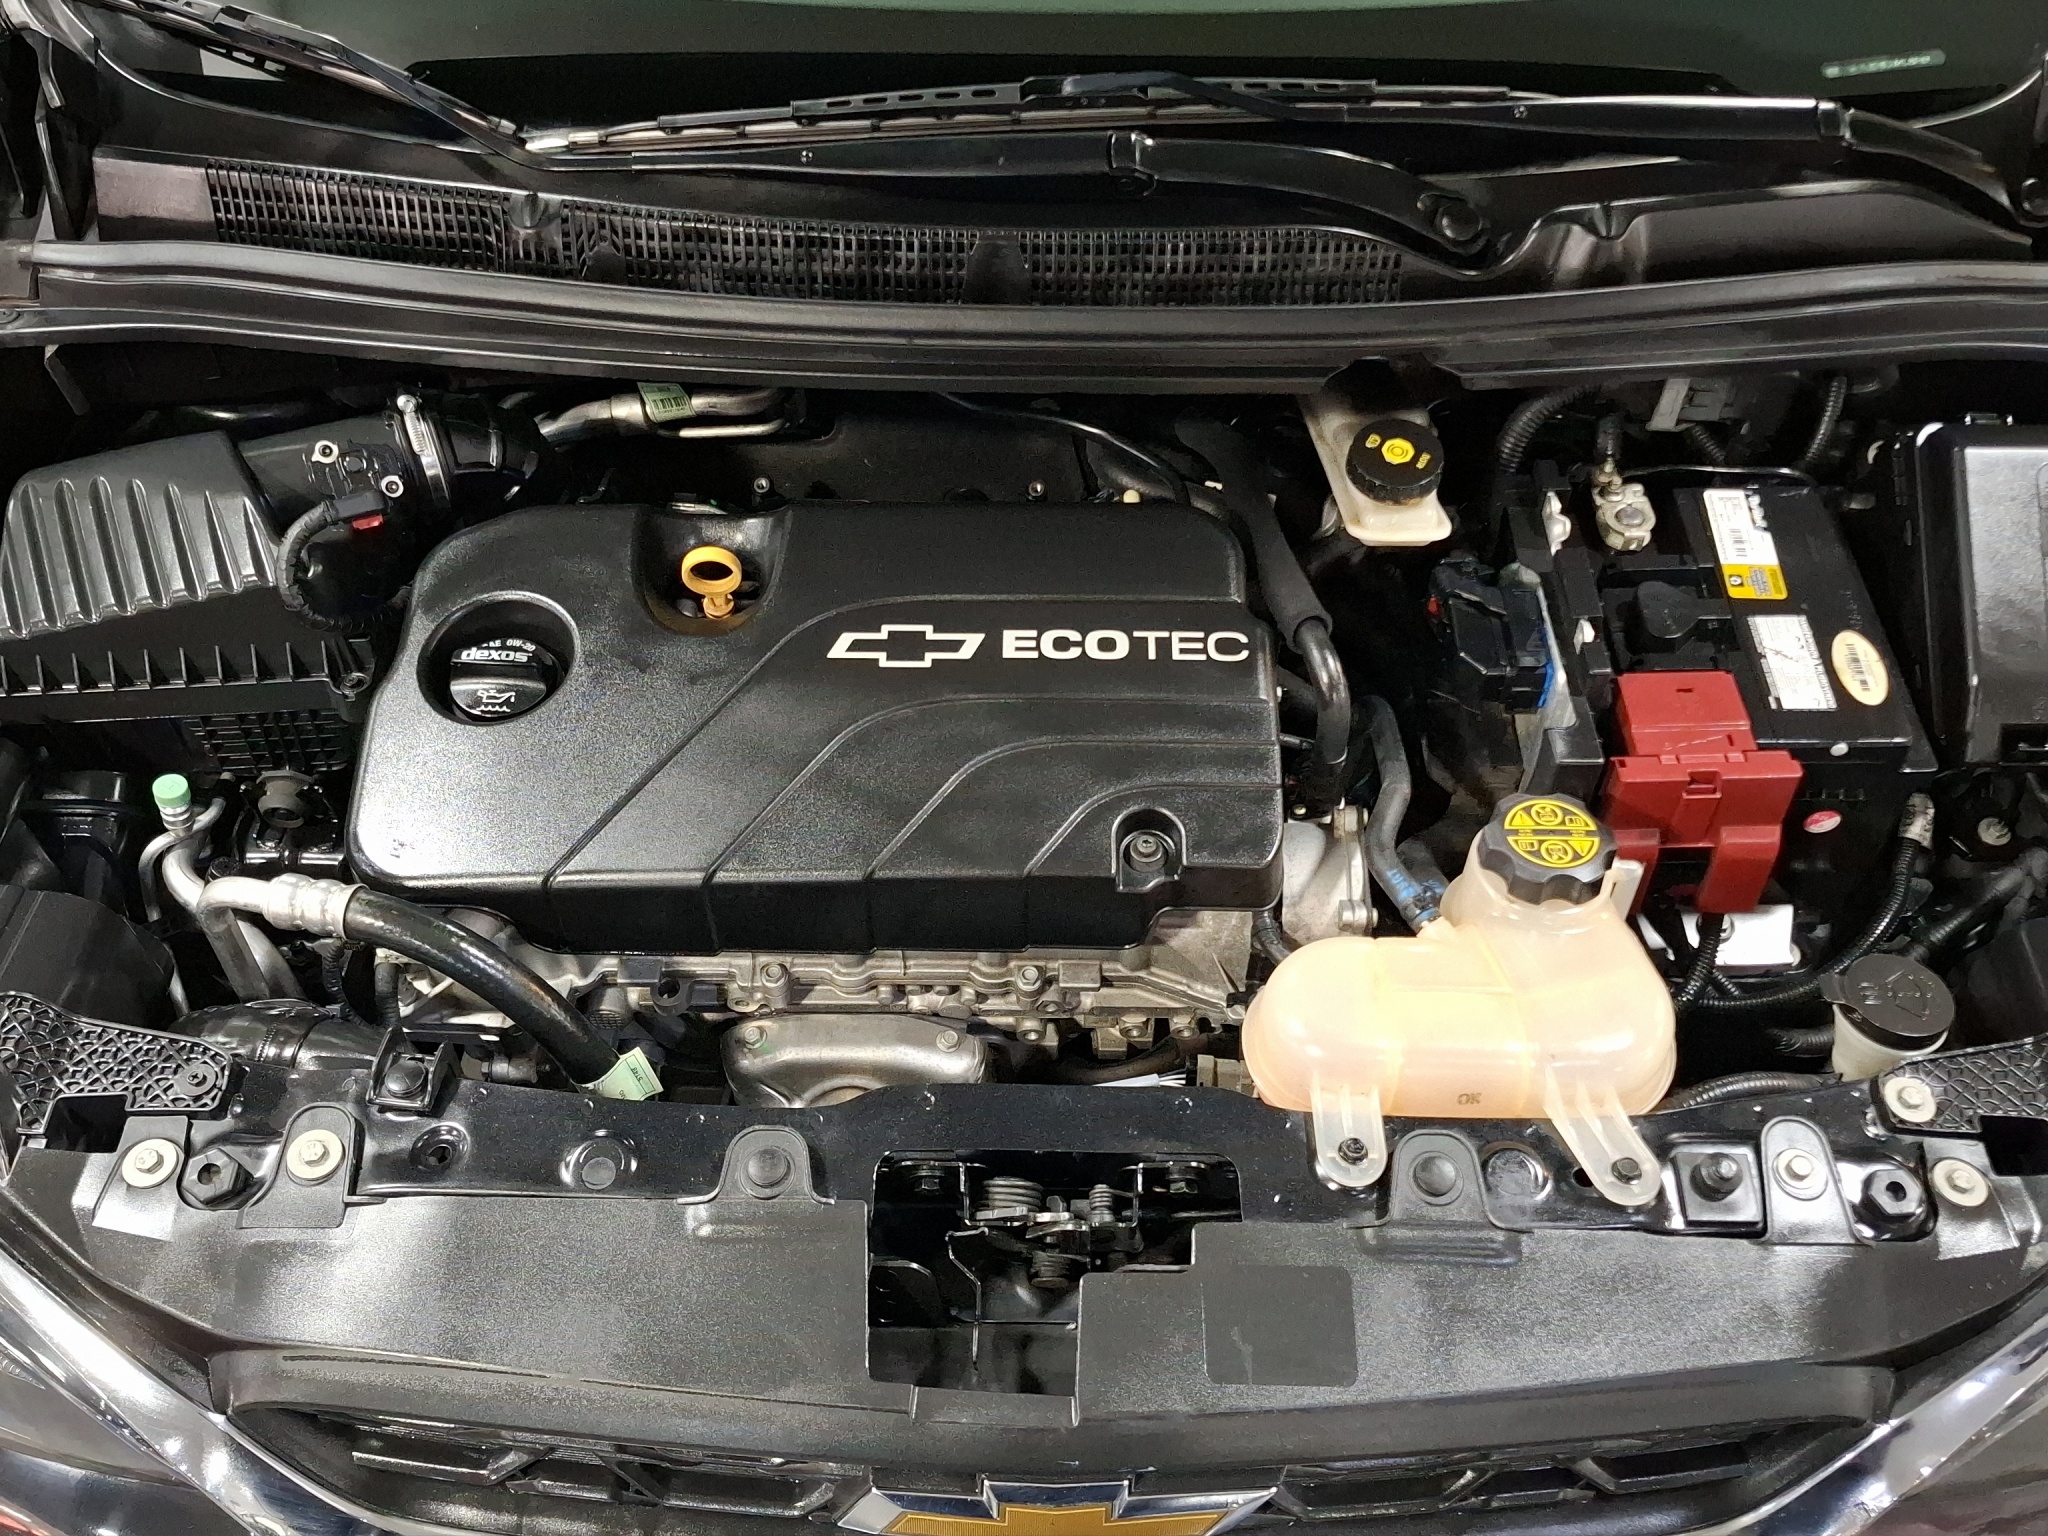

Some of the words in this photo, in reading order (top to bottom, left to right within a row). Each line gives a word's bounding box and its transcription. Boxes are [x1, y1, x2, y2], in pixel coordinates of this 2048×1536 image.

[505, 639, 536, 652] 0W-20
[1001, 628, 1250, 662] ECOTEC
[460, 646, 528, 663] dexos
[1457, 1092, 1482, 1106] OK
